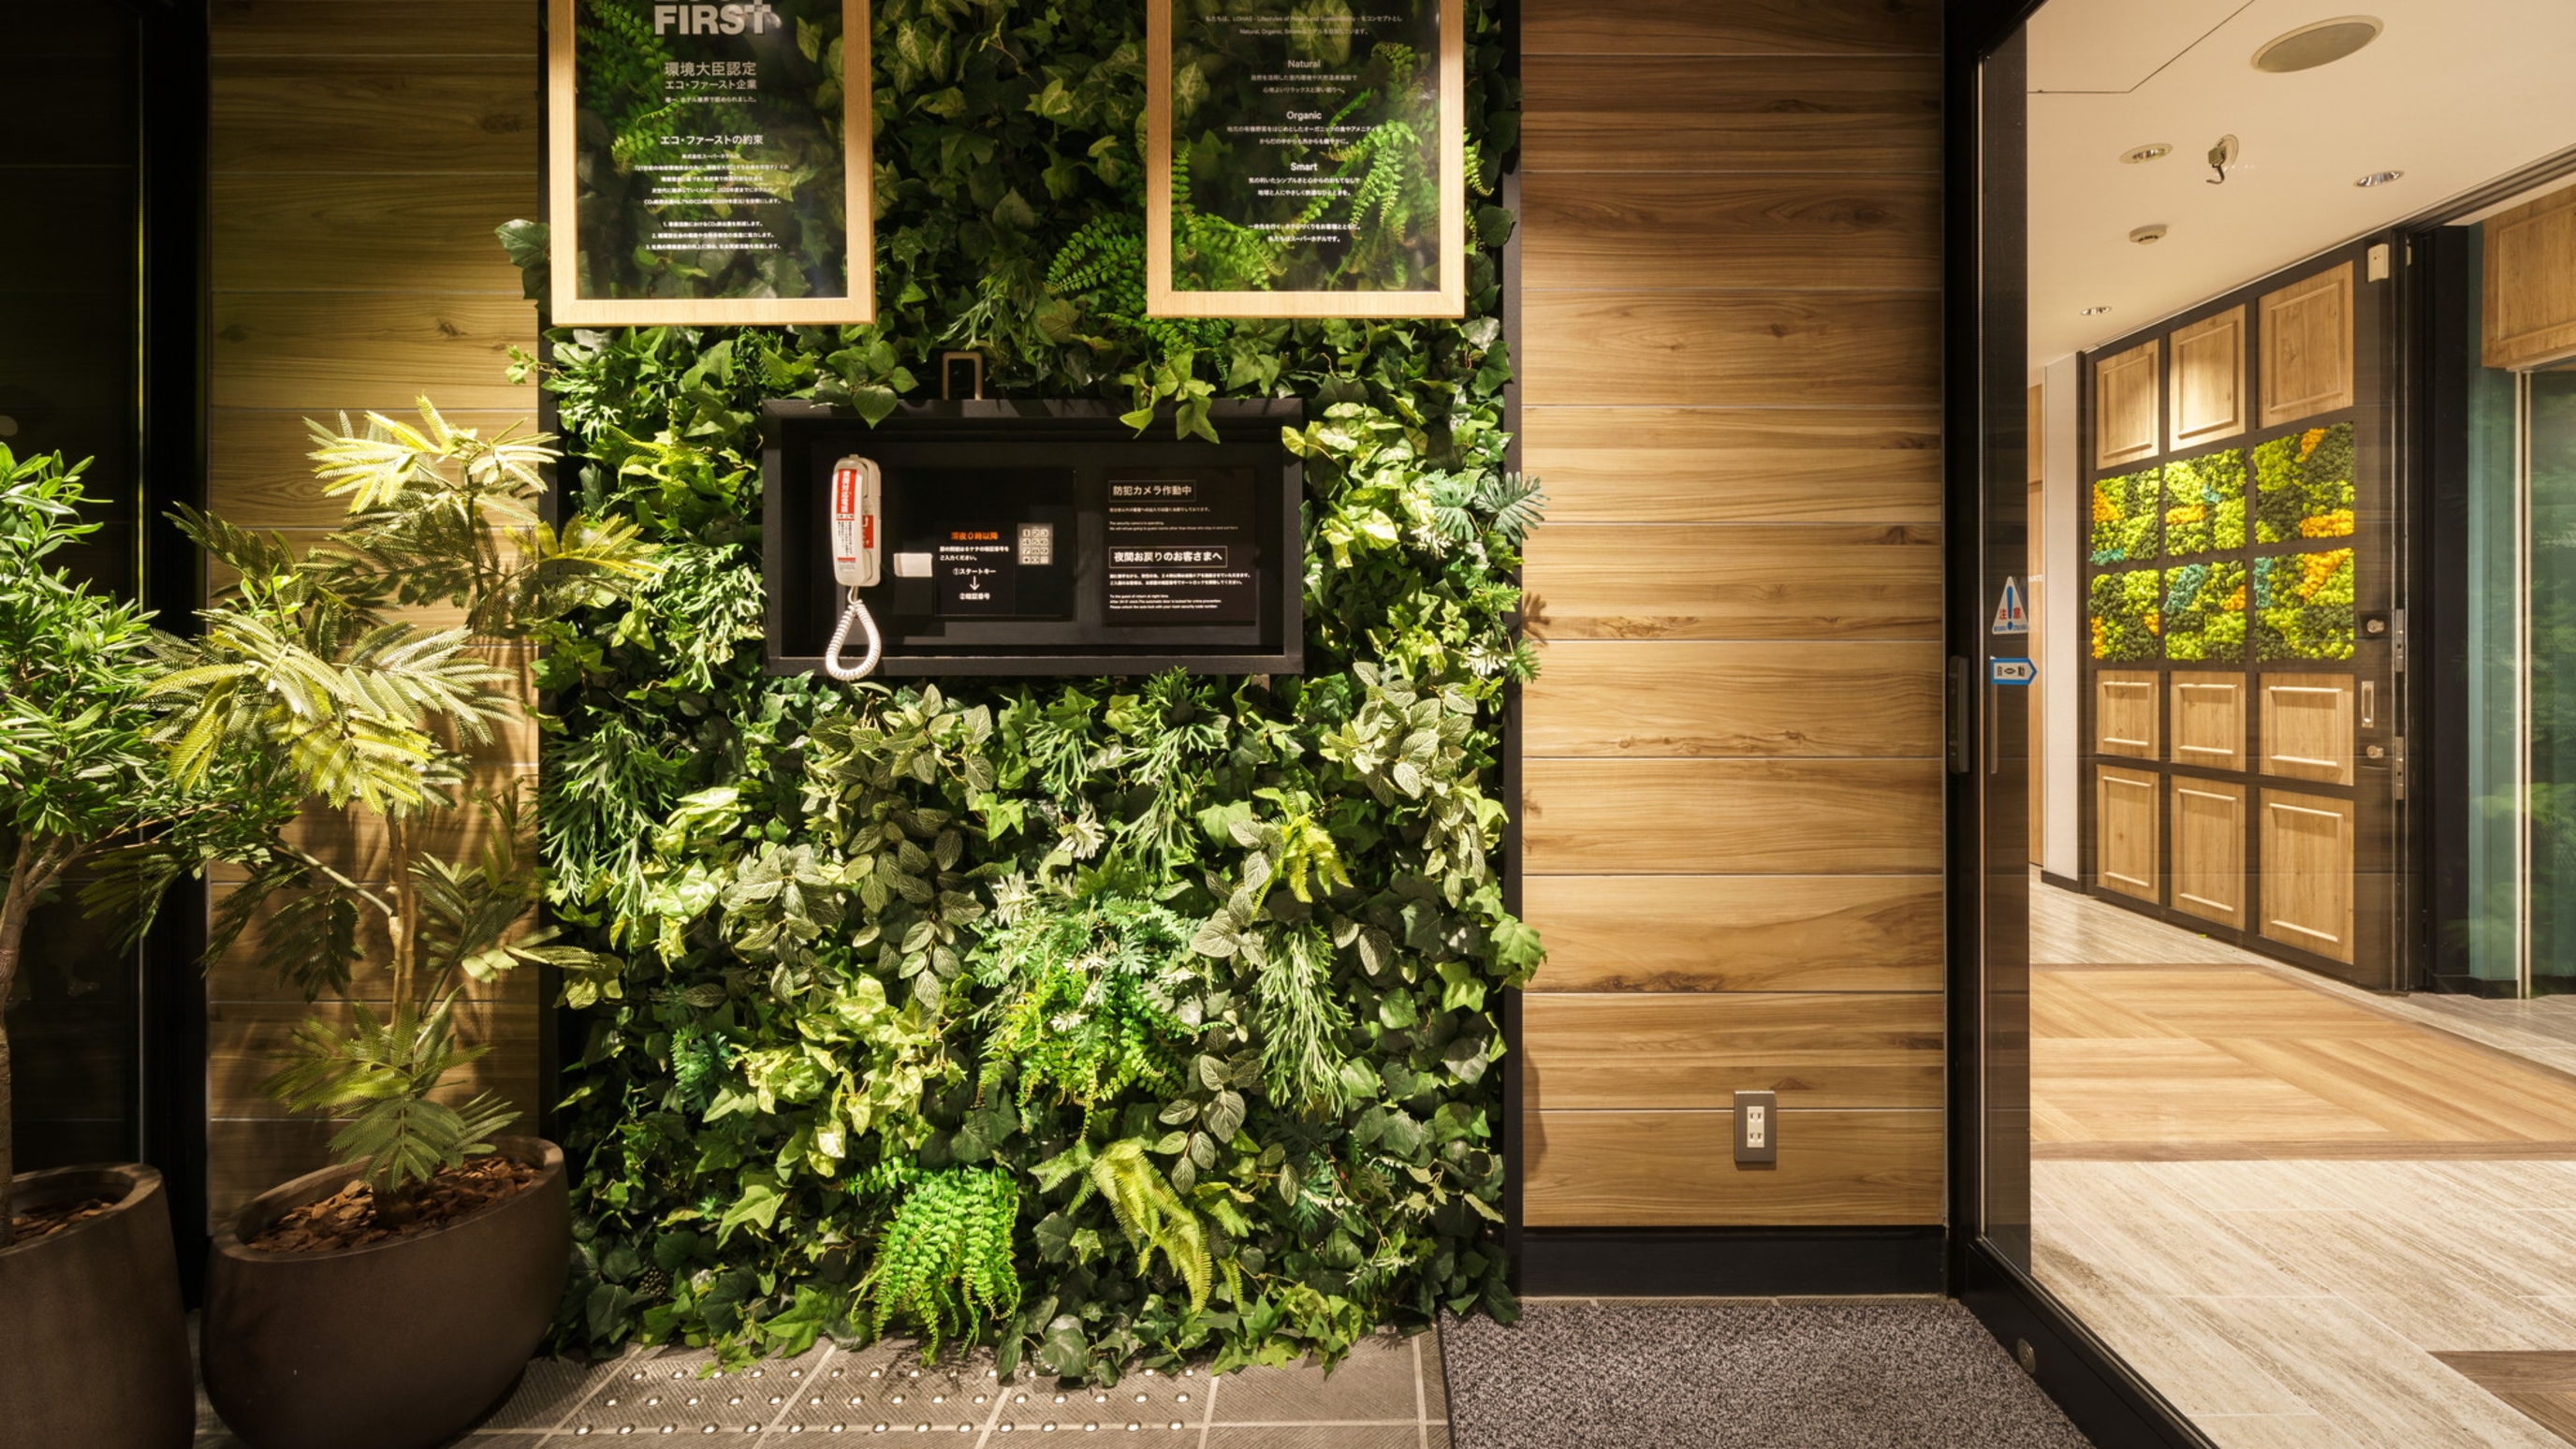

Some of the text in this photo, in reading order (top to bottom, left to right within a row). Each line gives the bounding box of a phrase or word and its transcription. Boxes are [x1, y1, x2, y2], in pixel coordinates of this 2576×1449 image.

[654, 1, 771, 35] FIRST
[665, 62, 757, 77] 環境大臣認定
[1287, 60, 1321, 68] Natural
[665, 80, 757, 90] エコ・ファースト企業
[1286, 110, 1322, 122] Organic
[660, 134, 764, 145] エコ・ファーストの約束
[1291, 162, 1318, 171] Smart
[1113, 485, 1193, 496] 防犯カメラ作動中
[1114, 551, 1222, 562] 夜間お戻りのお客さまへ
